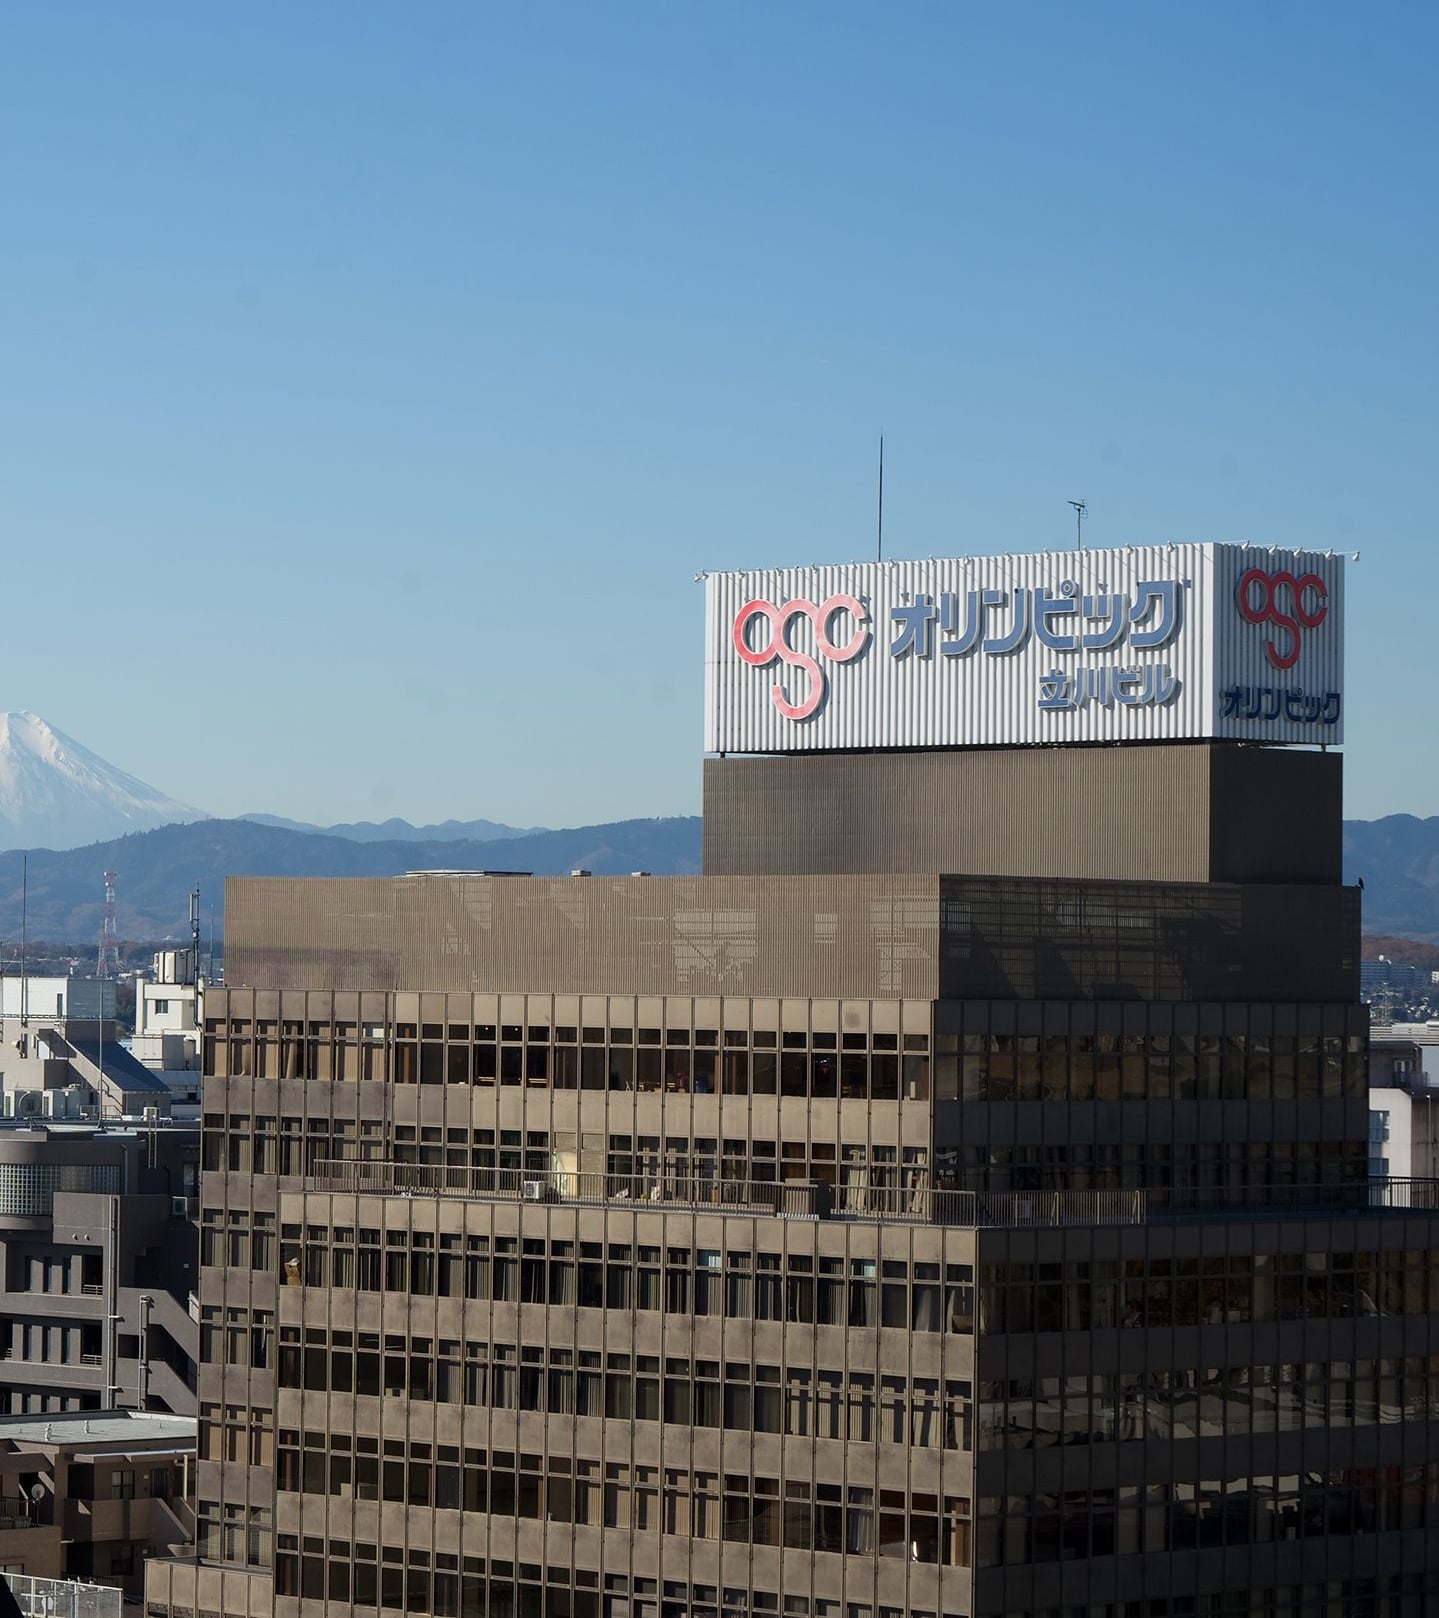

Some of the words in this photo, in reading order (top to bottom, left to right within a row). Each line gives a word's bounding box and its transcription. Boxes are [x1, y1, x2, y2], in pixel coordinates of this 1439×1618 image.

[890, 579, 1181, 657] オリンピック
[1038, 663, 1177, 709] 立川ビル
[1221, 685, 1341, 724] オリンピック
